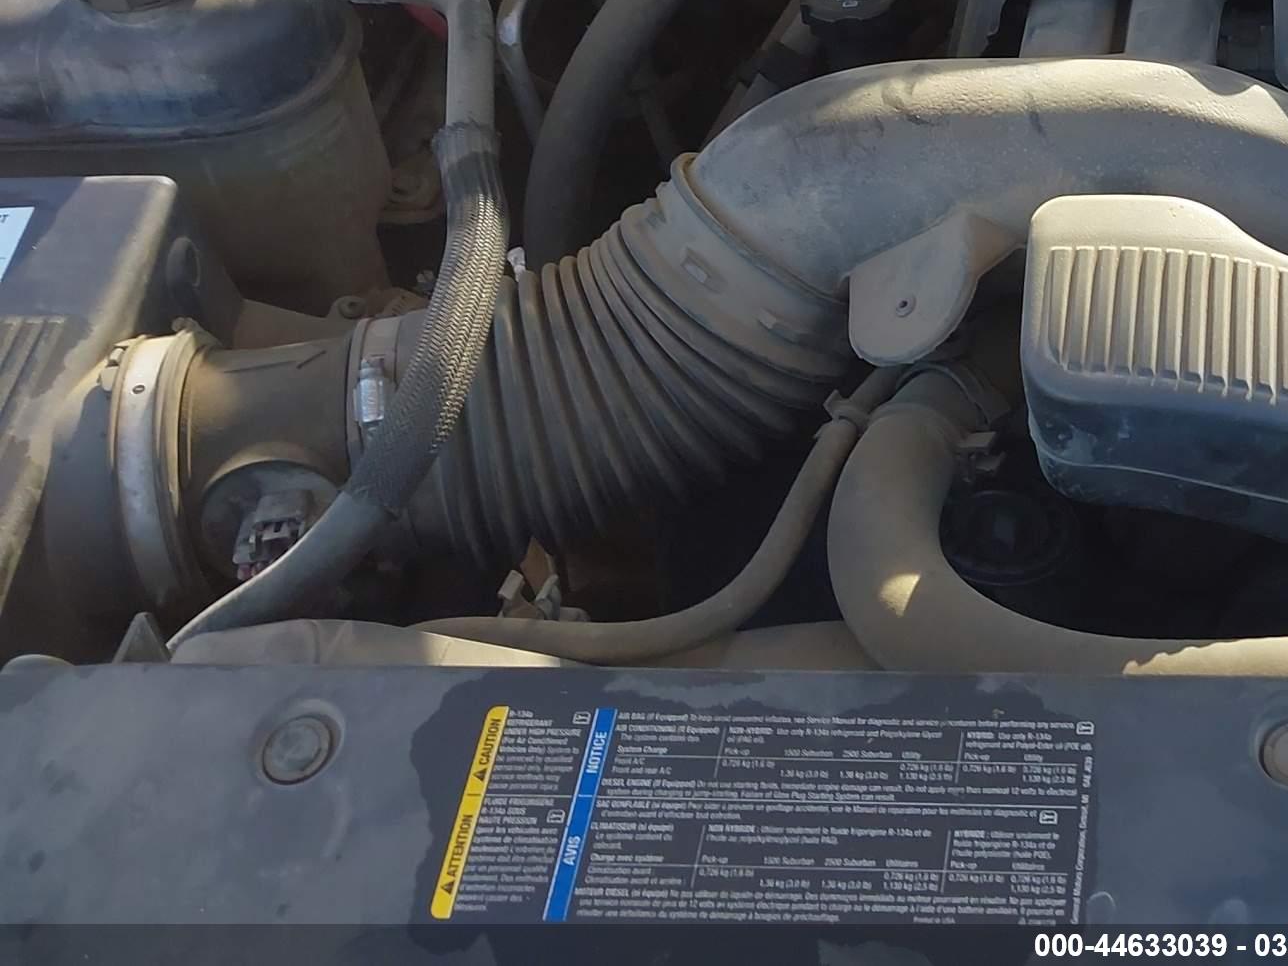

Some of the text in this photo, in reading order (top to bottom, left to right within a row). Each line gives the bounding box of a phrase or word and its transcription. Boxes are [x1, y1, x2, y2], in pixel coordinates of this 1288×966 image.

[479, 718, 502, 766] CAUTION
[585, 731, 608, 774] NOTICE
[449, 815, 473, 876] ATTENTION
[563, 835, 581, 866] AVIS
